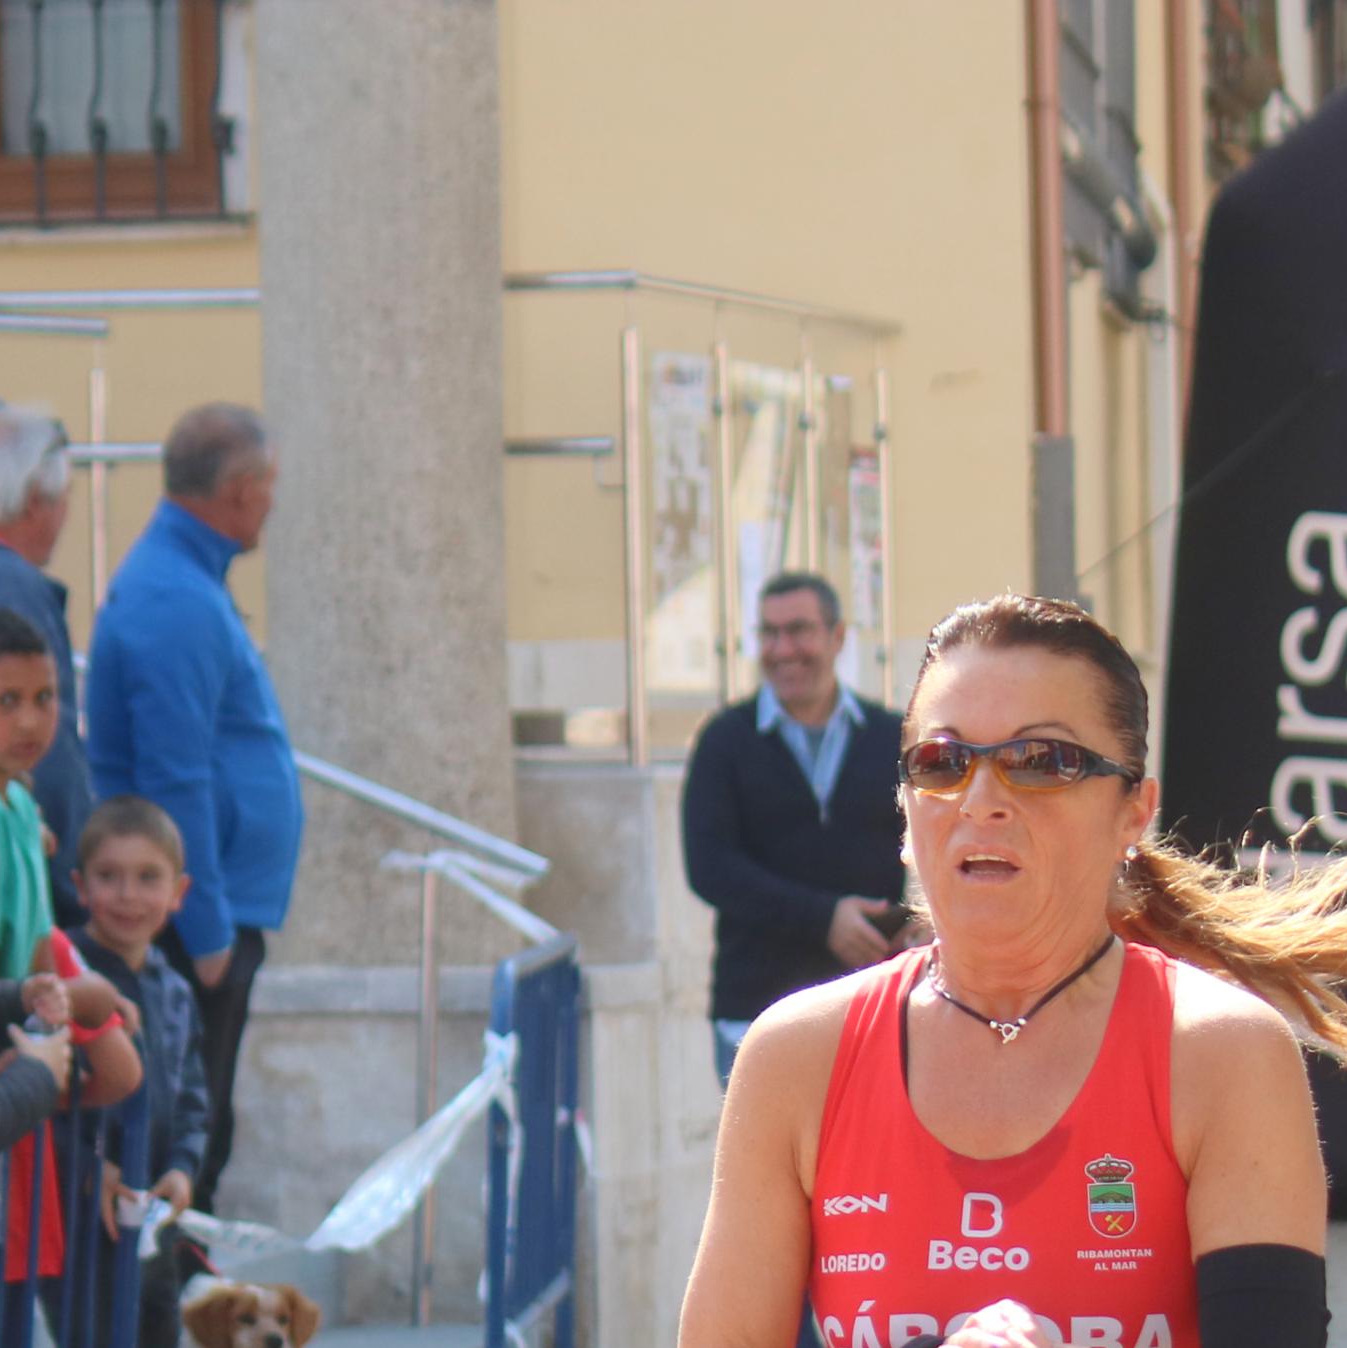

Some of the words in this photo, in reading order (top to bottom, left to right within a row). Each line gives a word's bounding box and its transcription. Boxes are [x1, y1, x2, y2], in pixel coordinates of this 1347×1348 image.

[927, 1239, 1030, 1271] Beco
[1077, 1249, 1152, 1260] RIBAMONTAN
[821, 1253, 886, 1274] LOREDO
[1094, 1262, 1109, 1271] AL
[1112, 1261, 1137, 1271] MAR
